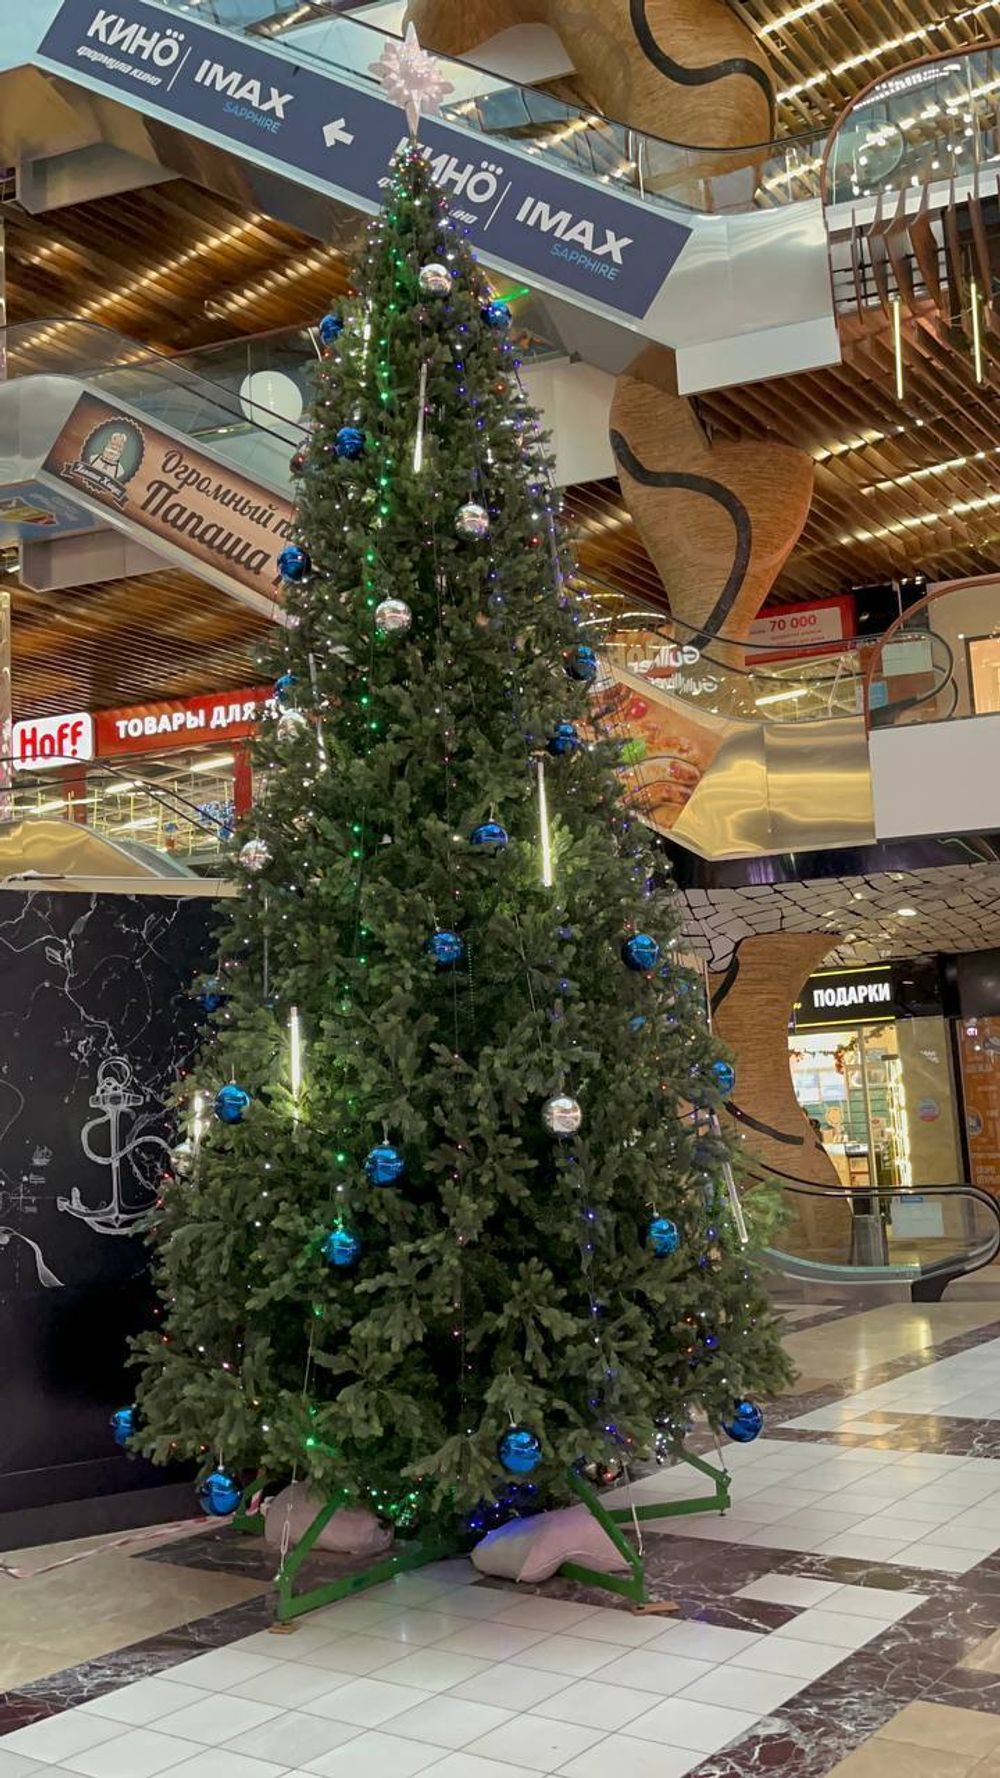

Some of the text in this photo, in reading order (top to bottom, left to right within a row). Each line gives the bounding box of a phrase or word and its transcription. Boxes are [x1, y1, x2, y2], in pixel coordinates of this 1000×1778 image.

[194, 59, 294, 119] IMAX
[222, 102, 281, 133] SAPPHIRE
[516, 196, 633, 265] IMAX
[551, 243, 621, 281] SAPPHIRE
[161, 449, 279, 529] Огромный
[140, 480, 271, 575] Папаша
[769, 614, 817, 632] 70 000
[115, 708, 205, 739] ТОВАРЫ
[210, 700, 256, 729] ДЛЯ
[20, 720, 83, 763] Hoff
[813, 982, 891, 1008] ПОДАРКИ
